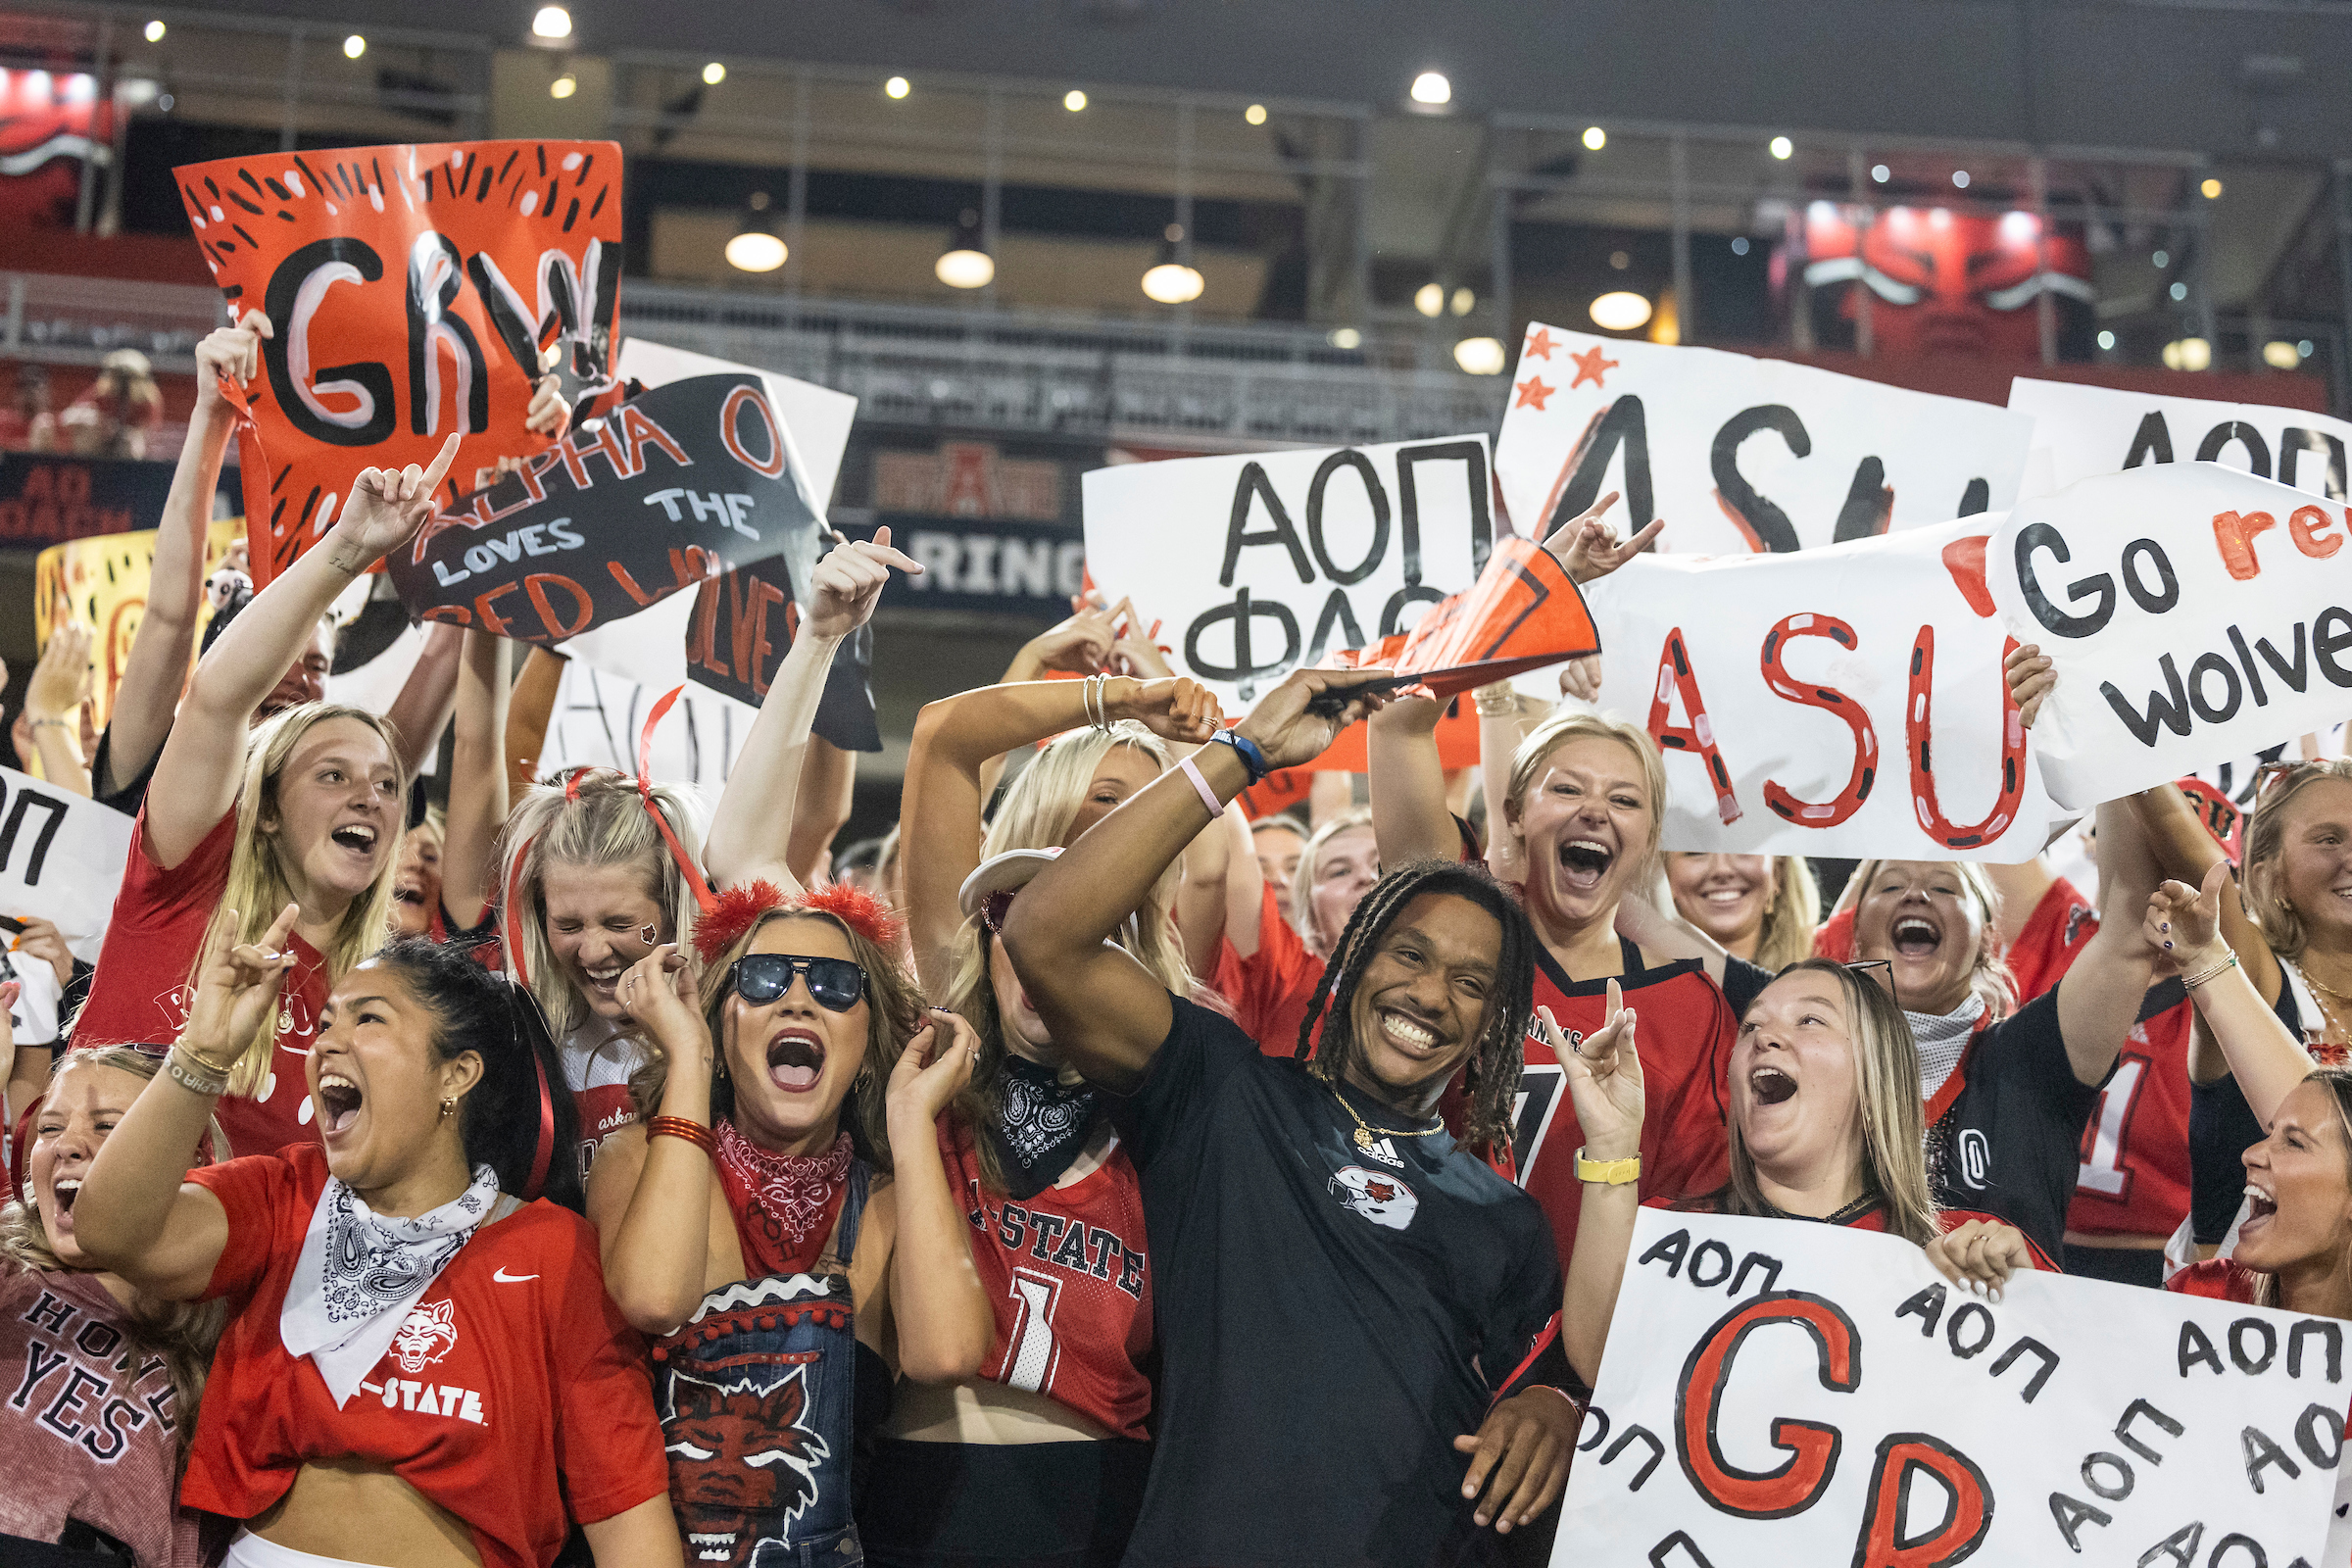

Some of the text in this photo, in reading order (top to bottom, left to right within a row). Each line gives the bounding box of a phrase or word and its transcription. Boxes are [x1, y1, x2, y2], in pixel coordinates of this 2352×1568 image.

[412, 384, 786, 565] ALPHA O
[432, 487, 761, 588] LOVES THE
[2014, 504, 2352, 639] Go re
[1648, 611, 2031, 850] ASU
[1357, 1146, 1405, 1169] adidas
[2077, 1053, 2153, 1202] 1
[999, 1265, 1064, 1396] 1
[8, 1337, 151, 1464] YES
[351, 1377, 484, 1425] -STATE
